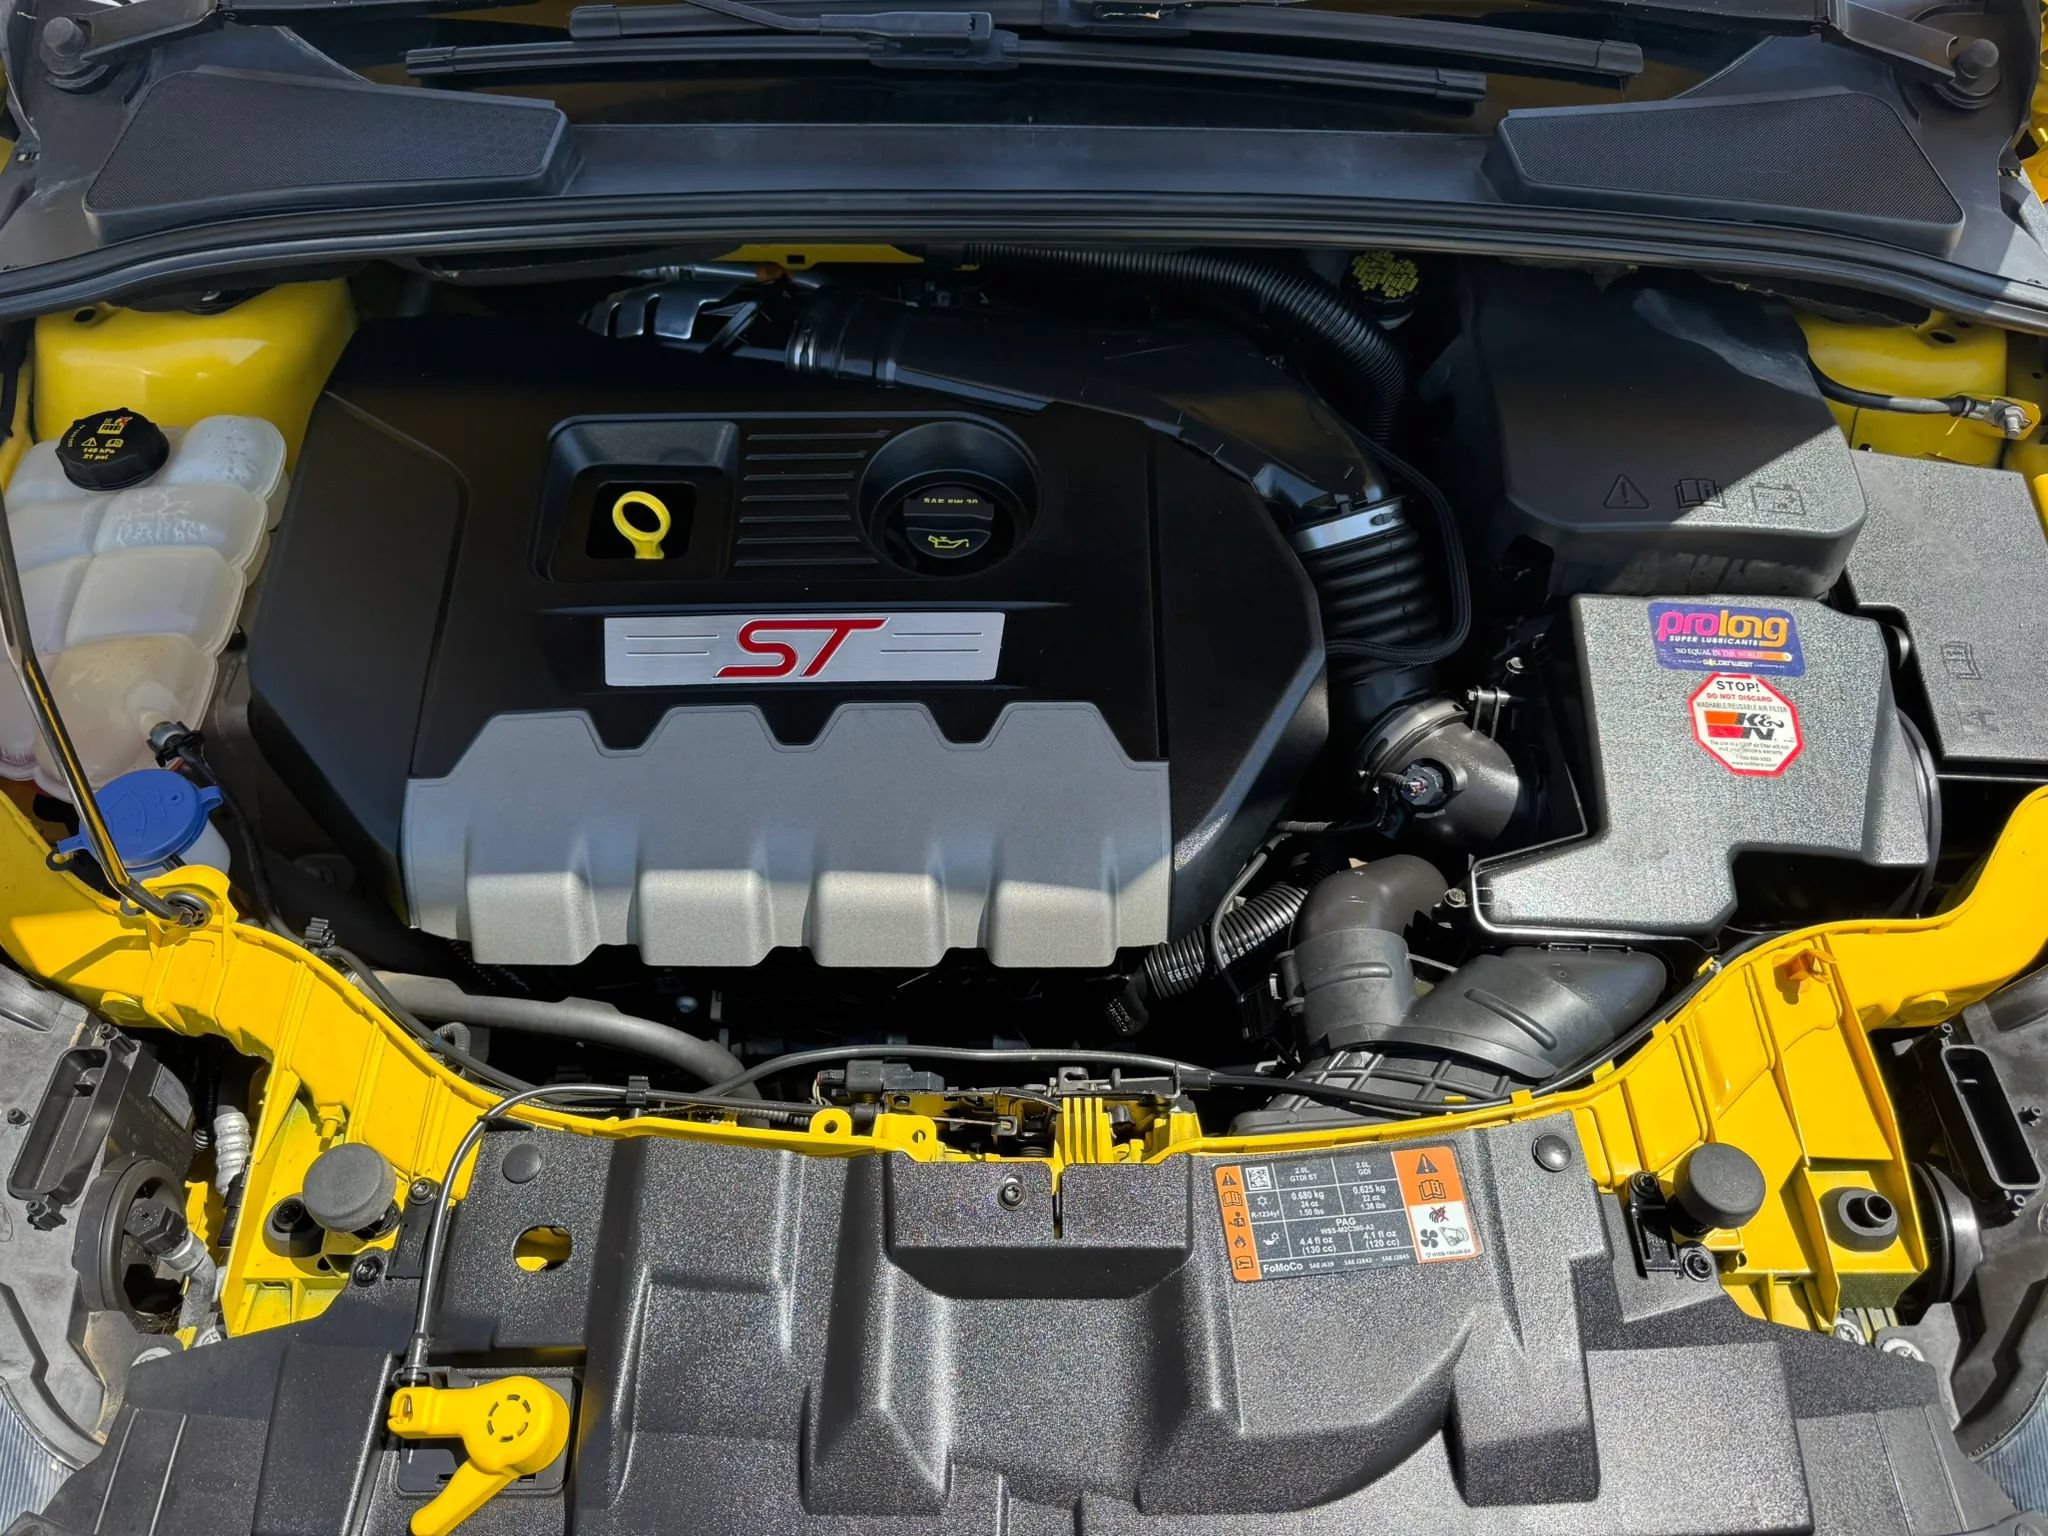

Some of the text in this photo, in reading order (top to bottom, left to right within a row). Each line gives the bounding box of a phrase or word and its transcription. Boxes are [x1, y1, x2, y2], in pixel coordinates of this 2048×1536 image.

[1655, 609, 1790, 648] prolong
[1668, 635, 1758, 646] SUPER LUBRICANTS
[712, 617, 891, 679] ST
[1716, 680, 1760, 692] STOP!
[1738, 694, 1773, 703] DISCARD
[1769, 705, 1789, 713] FILTER
[1352, 1184, 1386, 1195] 0.625 kg
[1314, 1190, 1325, 1200] kg
[1375, 1201, 1386, 1210] lbs
[1251, 1210, 1280, 1218] R-1234yf
[1313, 1207, 1325, 1216] lbs
[1335, 1217, 1357, 1227] PAG
[1363, 1231, 1377, 1240] 4.1
[1300, 1237, 1314, 1246] 4.4
[1314, 1236, 1321, 1245] fl
[1365, 1238, 1400, 1250] (120 cc)
[1302, 1244, 1337, 1256] (130 cc)
[1262, 1261, 1304, 1273] FoMoCo
